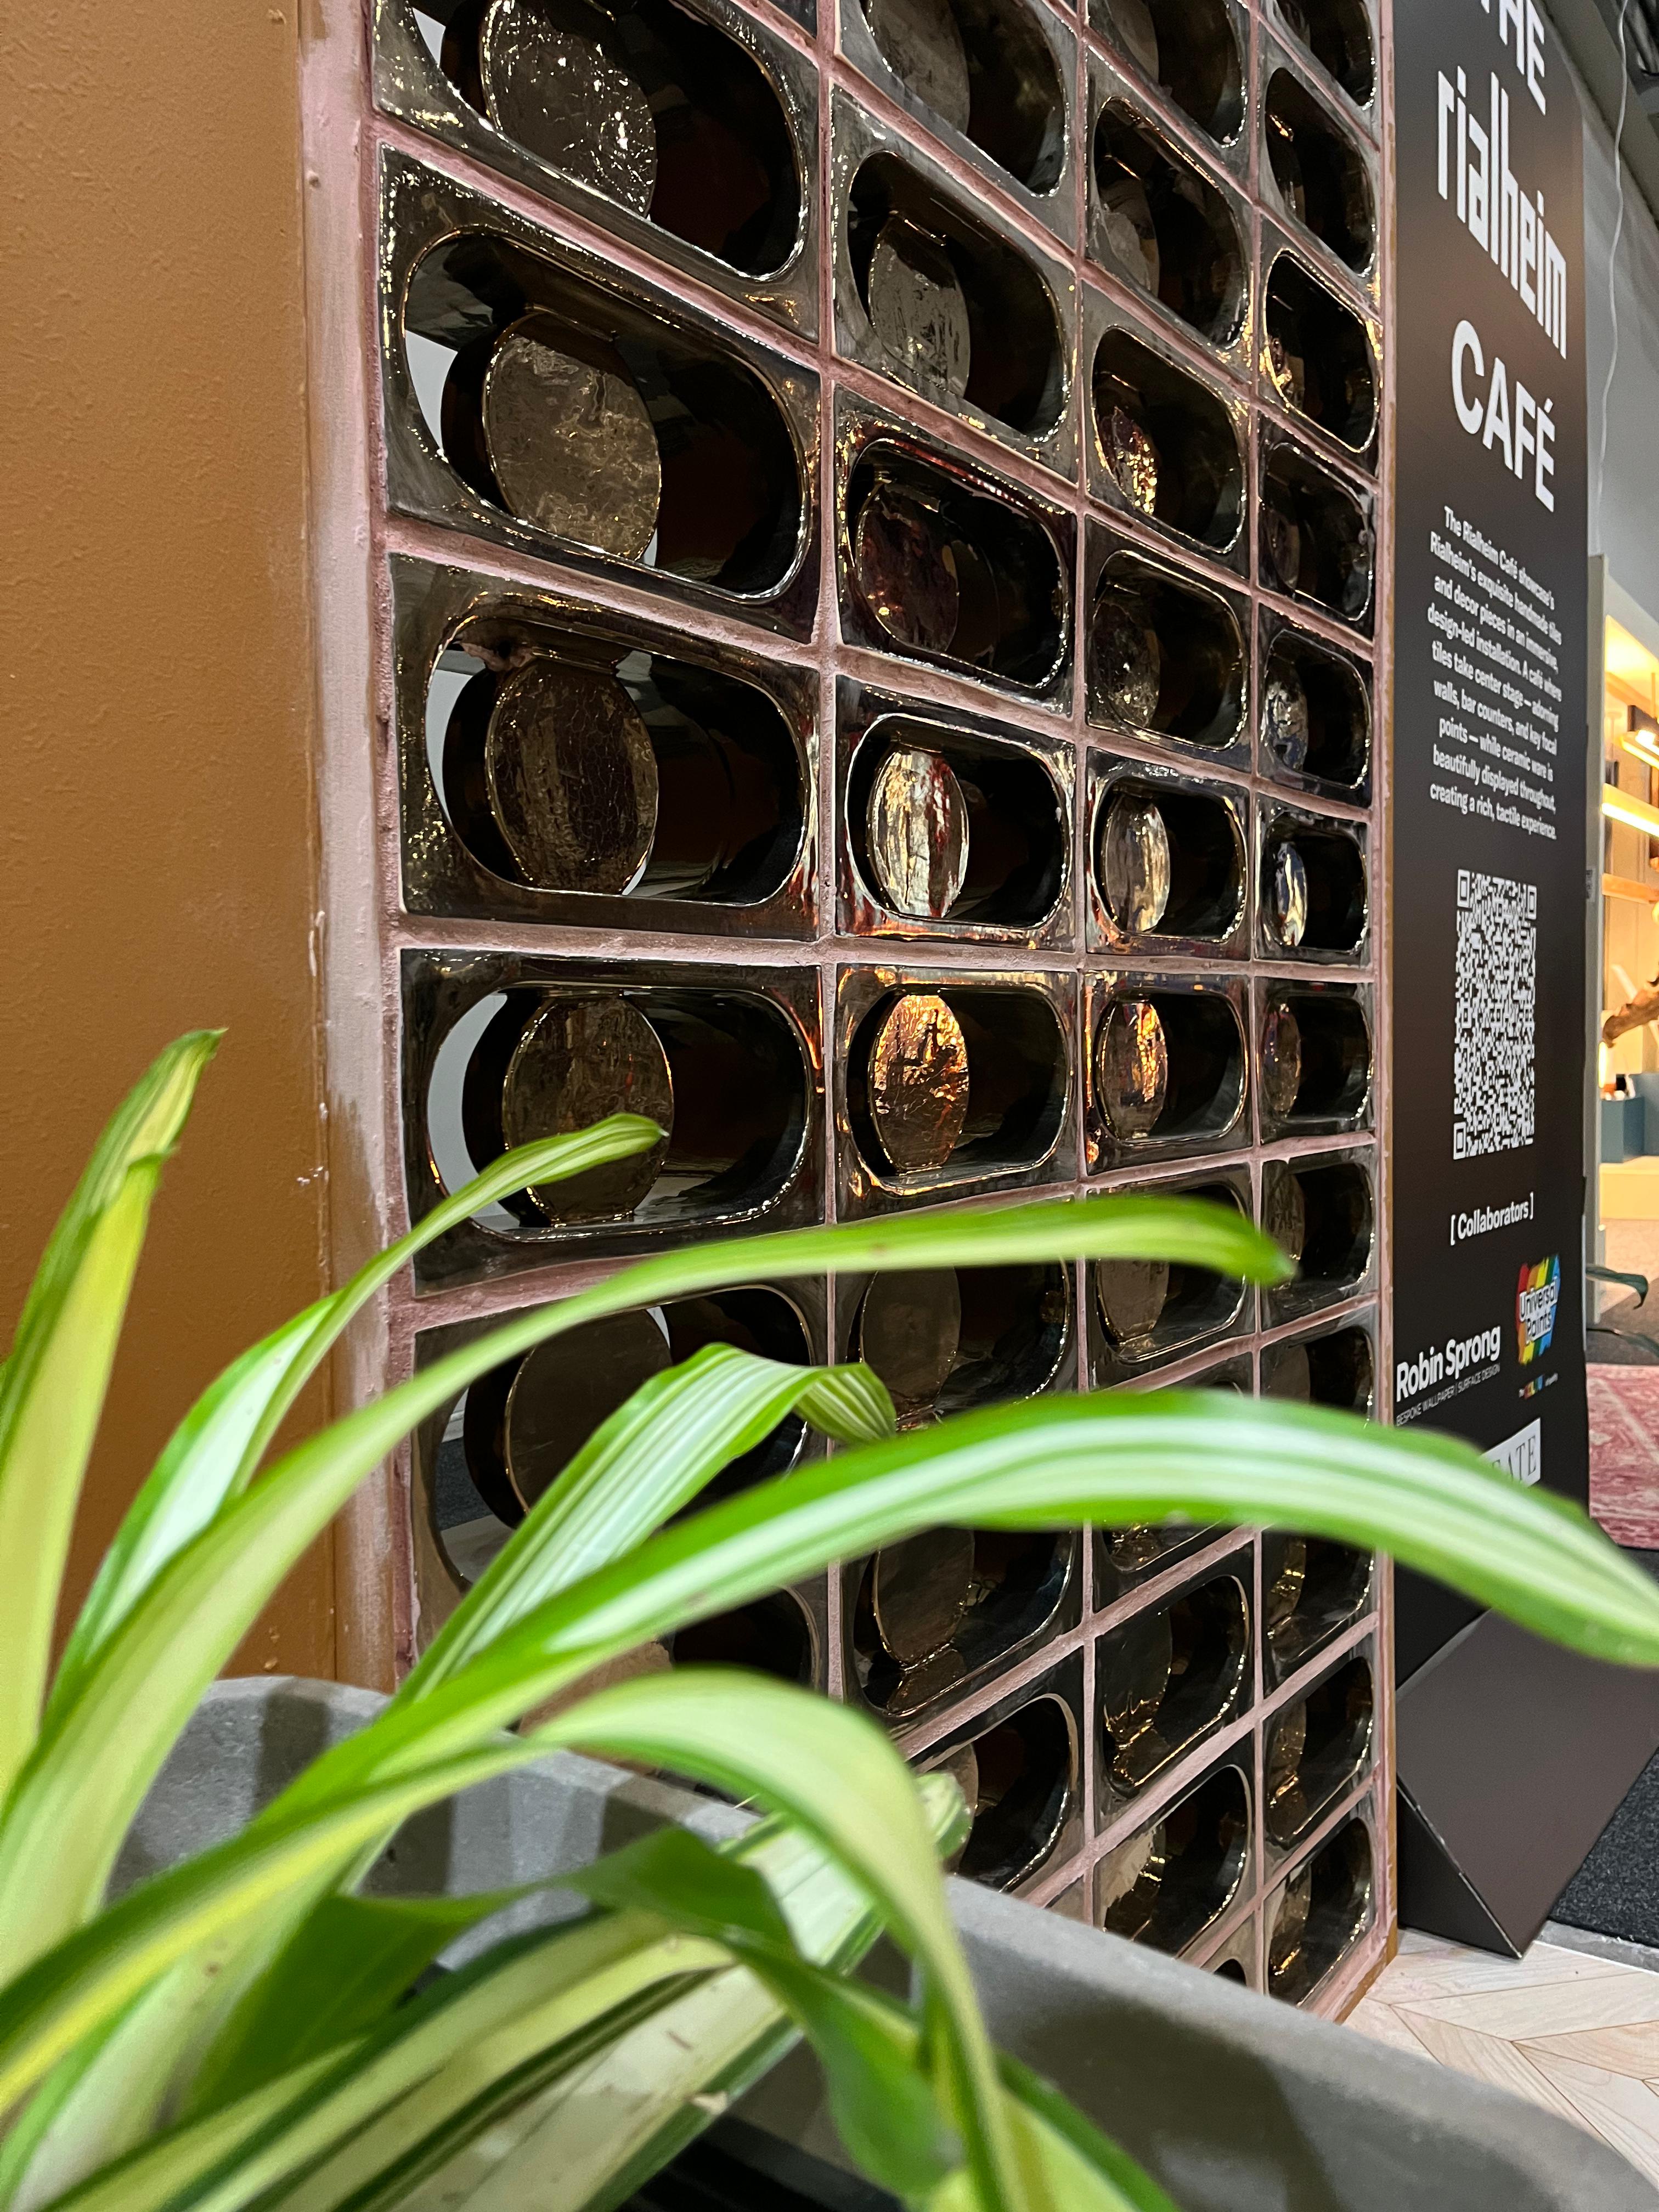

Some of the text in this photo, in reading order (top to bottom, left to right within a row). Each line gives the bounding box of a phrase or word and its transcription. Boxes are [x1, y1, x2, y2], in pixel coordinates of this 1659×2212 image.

[1481, 0, 1546, 115] HE
[1452, 320, 1555, 512] CAFÉ
[1444, 505, 1462, 537] The
[1463, 521, 1499, 566] Rialheim
[1499, 550, 1517, 579] Café
[1430, 531, 1561, 645] Rialheim's exquisite handmade tiles
[1434, 576, 1453, 600] and
[1454, 584, 1479, 617] decor
[1480, 603, 1506, 634] pieces
[1507, 618, 1515, 640] in
[1516, 629, 1525, 647] an
[1427, 602, 1475, 647] design-led
[1476, 630, 1521, 675] installation.
[1522, 660, 1528, 680] A
[1544, 677, 1562, 702] where
[1432, 640, 1452, 669] tiles
[1454, 652, 1474, 680] take
[1475, 668, 1502, 694] center
[1503, 682, 1523, 709] stage
[1434, 680, 1557, 755] walls, bar counters, and key focal
[1440, 716, 1468, 743] points
[1480, 733, 1500, 758] while
[1502, 746, 1531, 771] ceramic
[1532, 760, 1547, 778] ware
[1548, 763, 1553, 782] is
[1433, 743, 1480, 786] beautifully
[1482, 764, 1519, 796] displayed
[1430, 783, 1557, 839] creating a rich, tactile experience.
[1520, 1277, 1558, 1321] Universal
[1396, 1325, 1501, 1402] Robin Sprong
